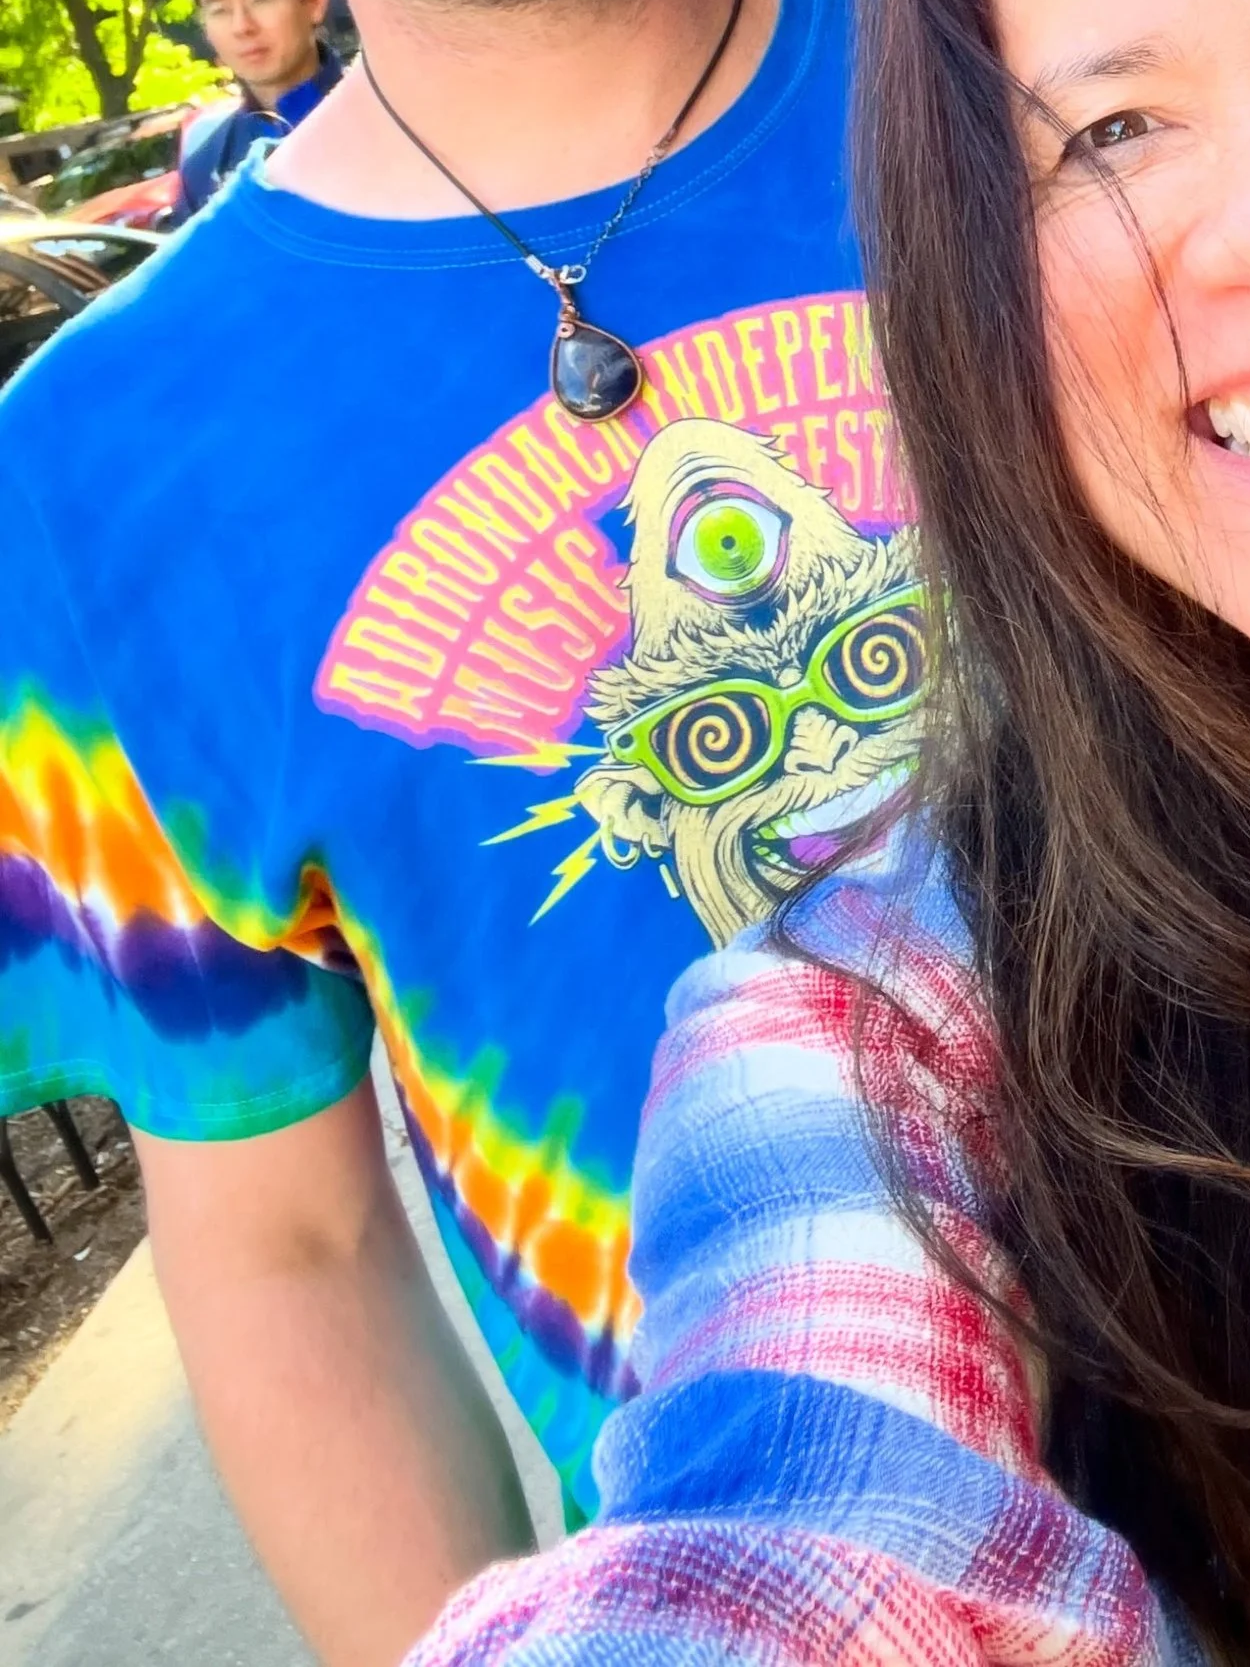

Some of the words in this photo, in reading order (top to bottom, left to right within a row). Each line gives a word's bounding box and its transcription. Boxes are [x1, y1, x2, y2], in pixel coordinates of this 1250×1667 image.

[641, 300, 891, 428] INDEPEN
[438, 527, 629, 746] MUSIC
[769, 408, 908, 512] FEST
